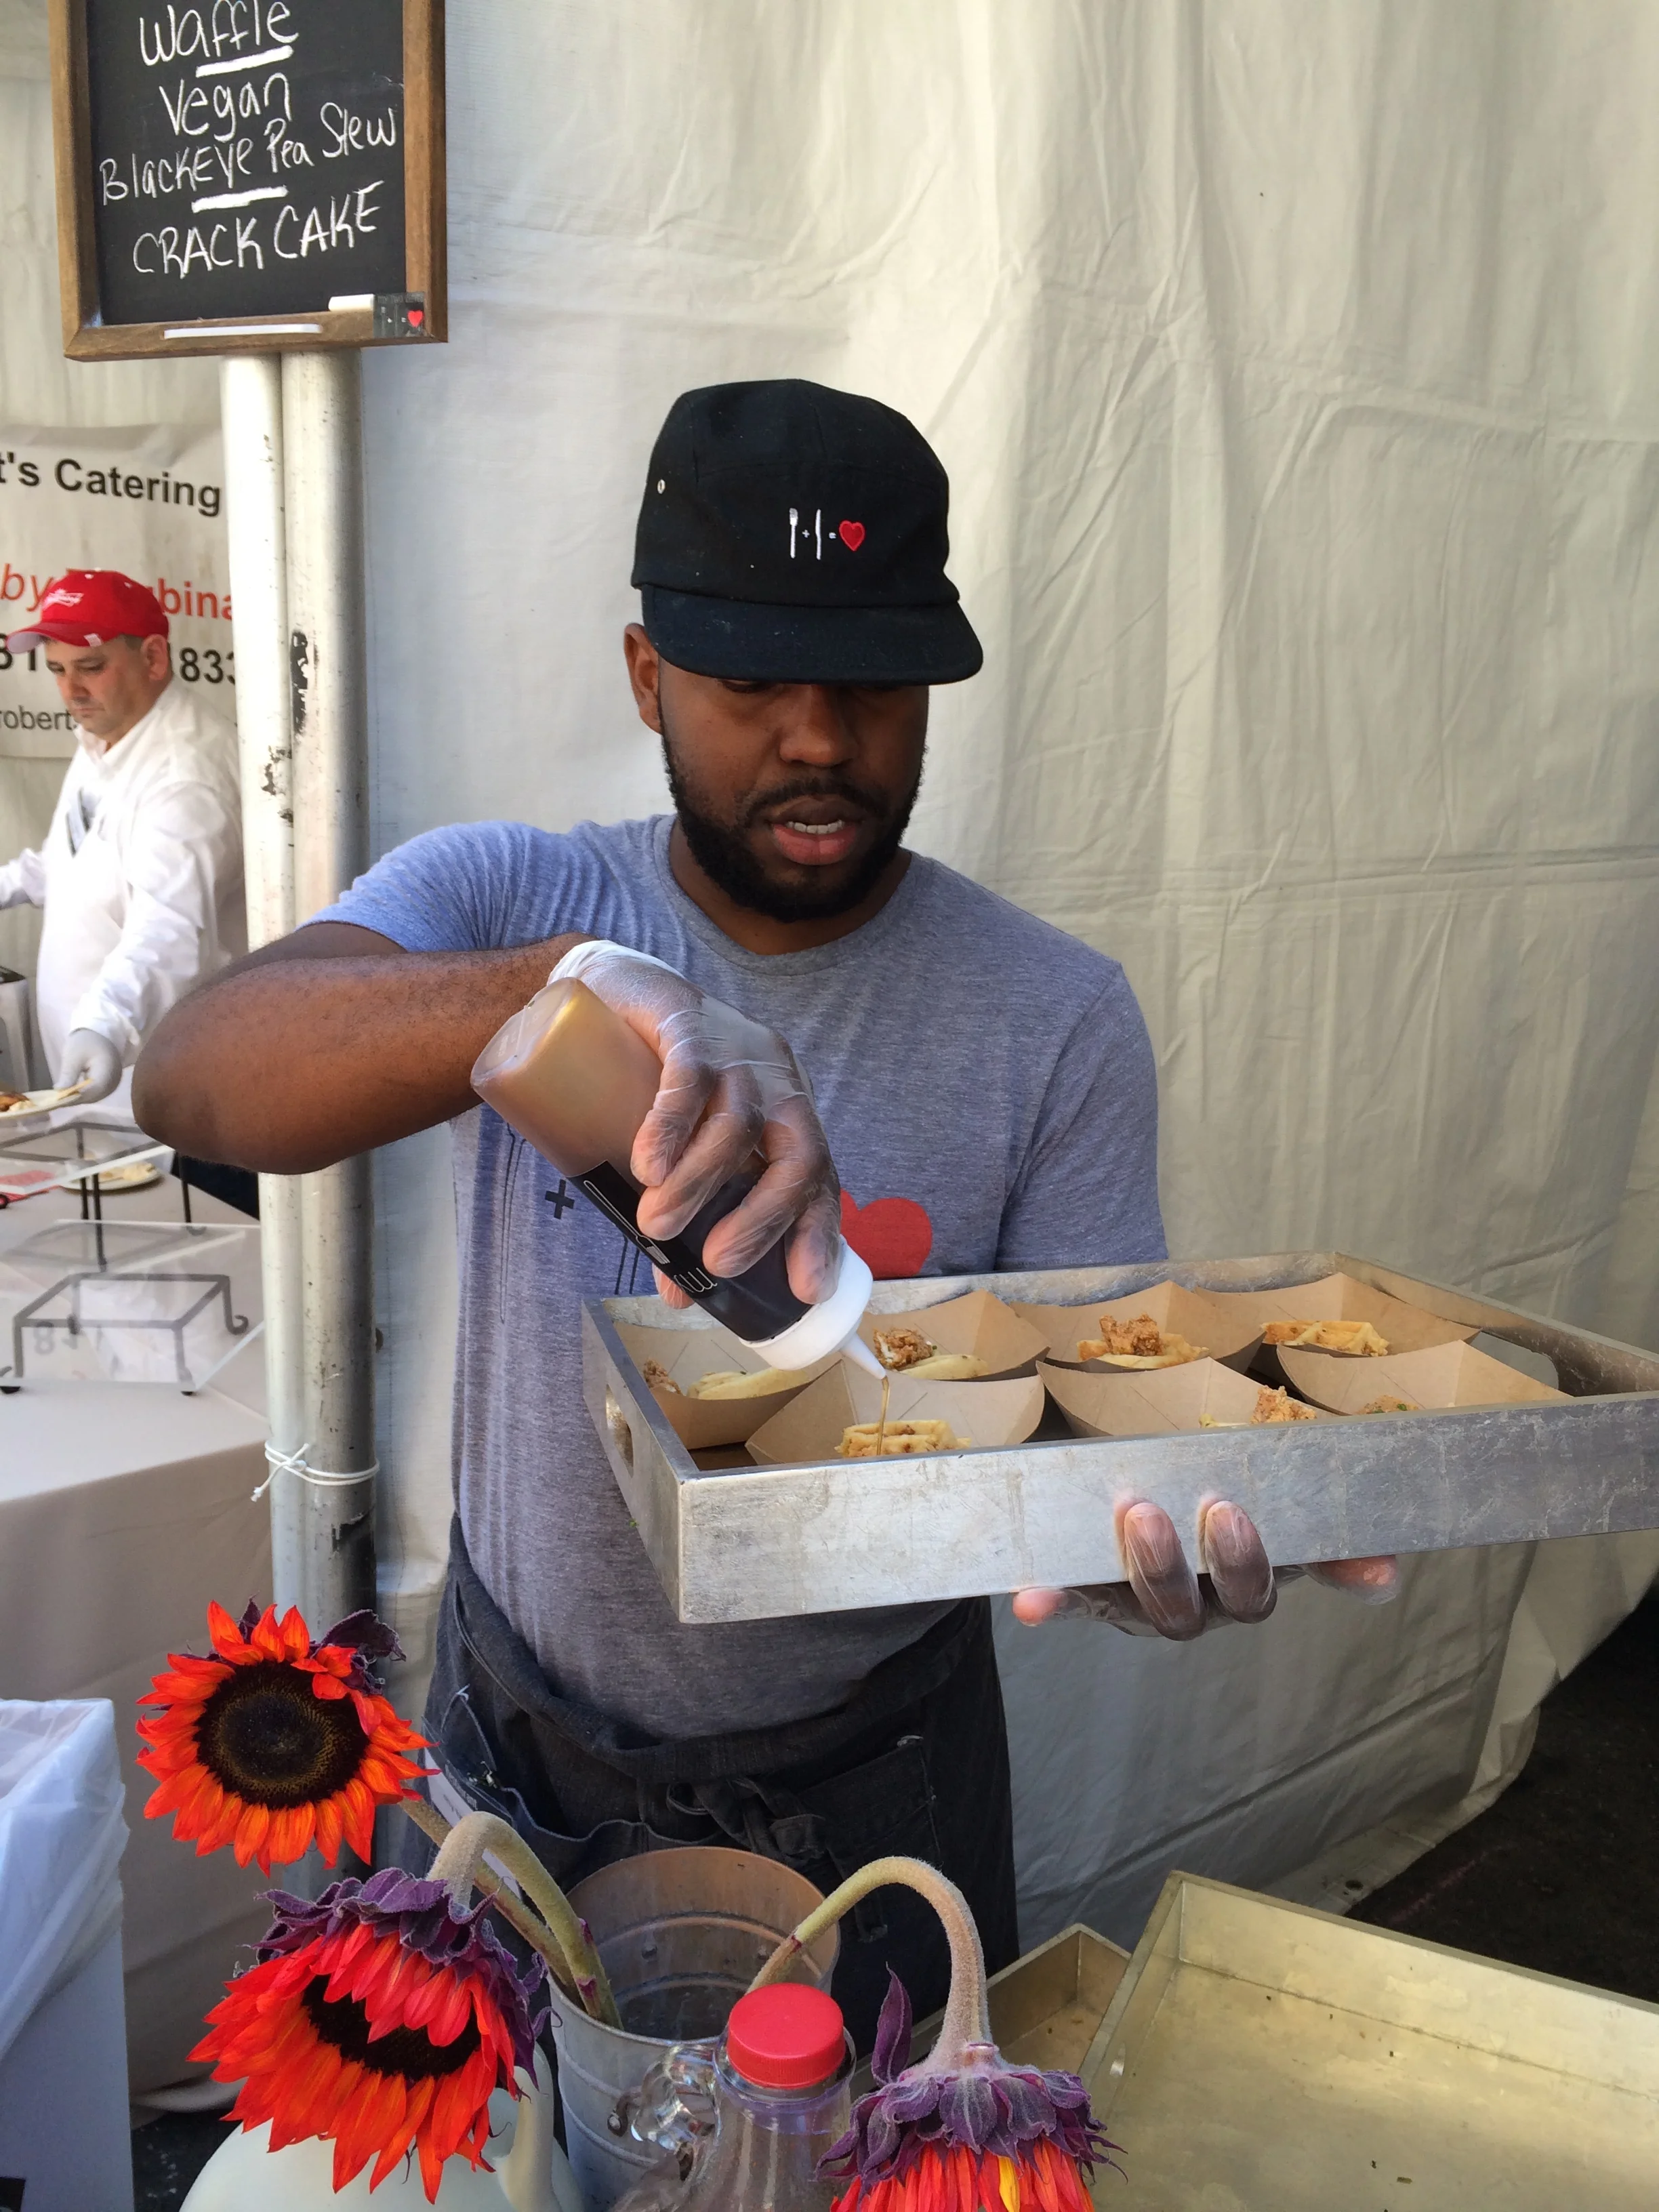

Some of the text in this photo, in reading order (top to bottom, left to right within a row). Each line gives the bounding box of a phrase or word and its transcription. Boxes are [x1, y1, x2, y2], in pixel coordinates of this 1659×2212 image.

[159, 73, 292, 142] Vegan
[264, 118, 315, 173] Pea
[321, 102, 396, 157] Stew
[133, 180, 384, 279] CRACK CAKE
[55, 458, 220, 516] Catering
[1, 563, 54, 611] by
